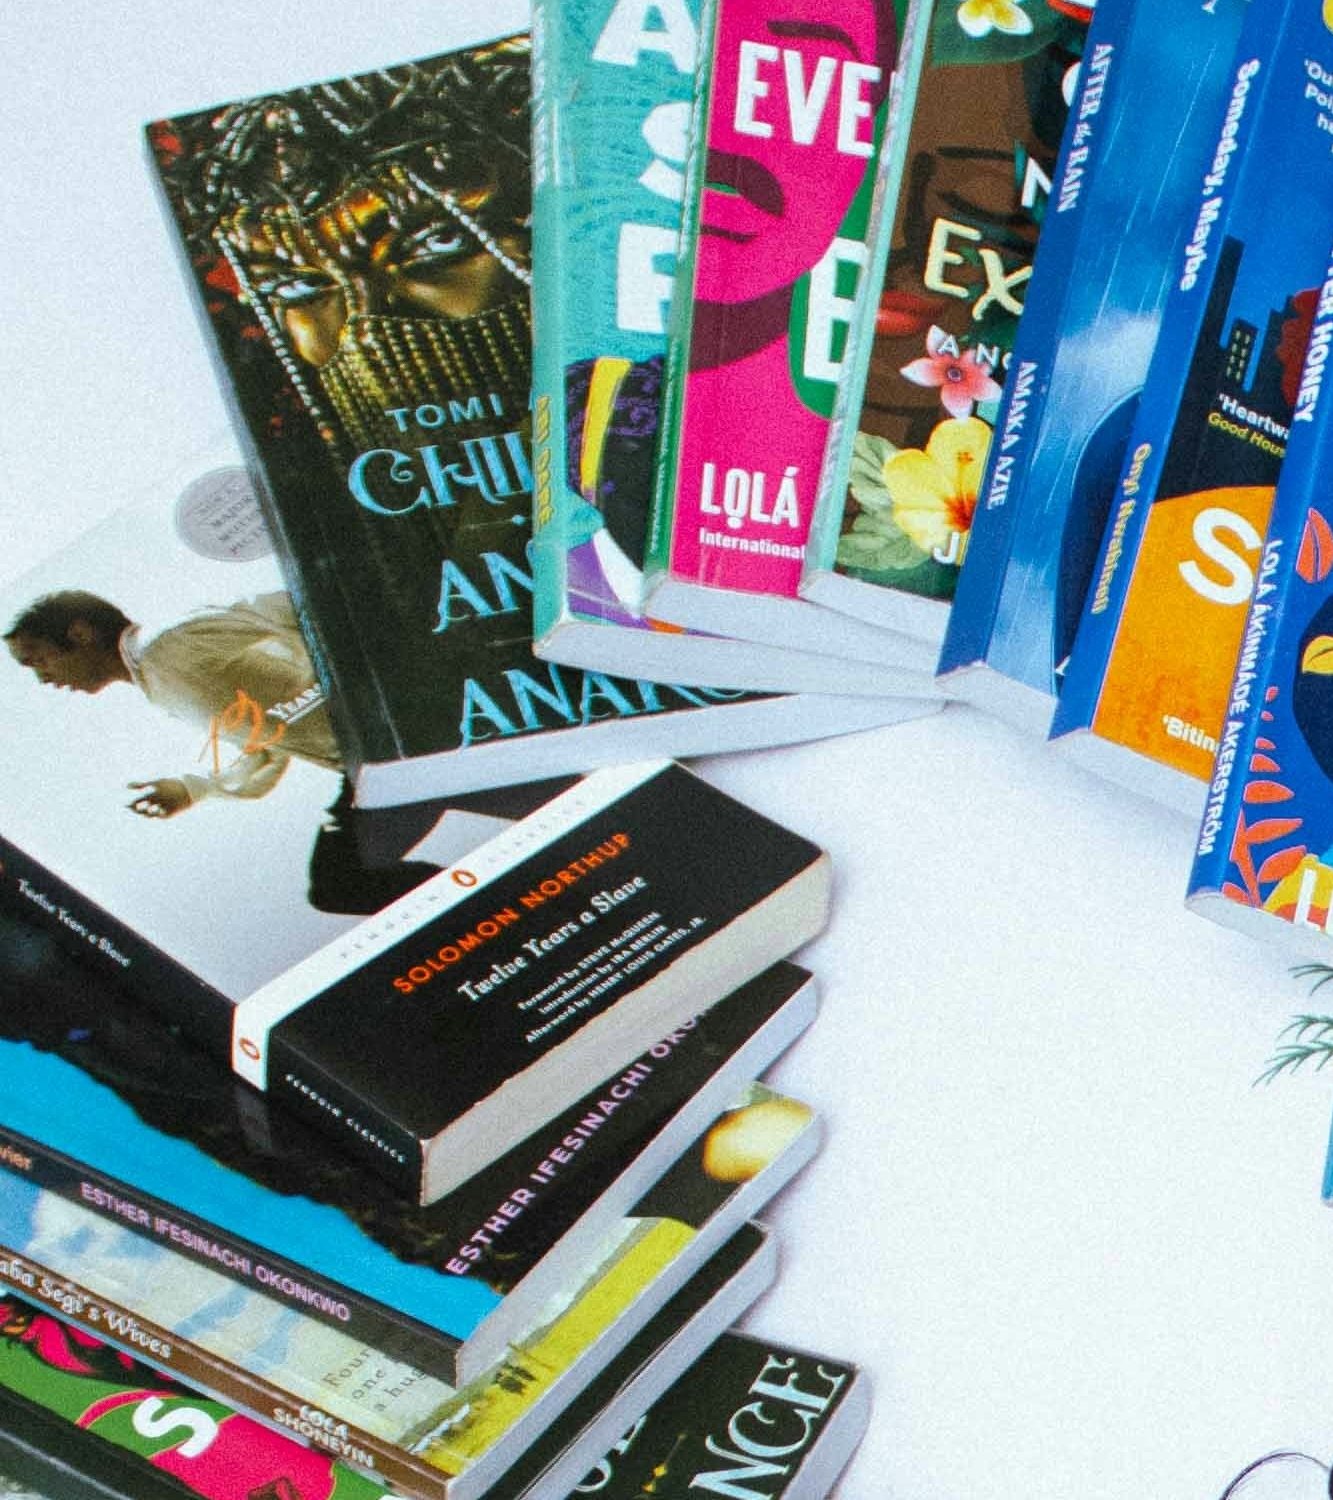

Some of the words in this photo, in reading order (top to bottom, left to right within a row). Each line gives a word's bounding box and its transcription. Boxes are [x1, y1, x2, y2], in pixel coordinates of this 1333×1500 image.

[733, 40, 902, 158] EVE
[1080, 43, 1114, 119] AFTER
[1202, 58, 1261, 196] Someday,
[1055, 145, 1091, 214] RAIN
[1180, 197, 1222, 292] Maybe
[384, 393, 502, 433] TOMI
[1000, 361, 1038, 450] AMAKA
[1207, 411, 1252, 442] Good
[987, 453, 1016, 511] AZIE
[1123, 442, 1152, 497] Onyi
[392, 906, 521, 995] SOLOMON
[519, 830, 631, 911] NORTHUP
[456, 954, 529, 1003] Twelve
[521, 920, 581, 961] Years
[578, 908, 597, 925] a
[590, 874, 648, 914] Slave
[446, 1186, 538, 1277] ESTHER
[531, 1062, 653, 1185] IFESINACHI
[80, 1181, 152, 1227] ESTHER
[153, 1217, 253, 1278] IFESINACHI
[255, 1263, 353, 1324] OKONKWO
[103, 1308, 174, 1362] Wives
[321, 1347, 373, 1389] Four
[350, 1367, 389, 1401] one
